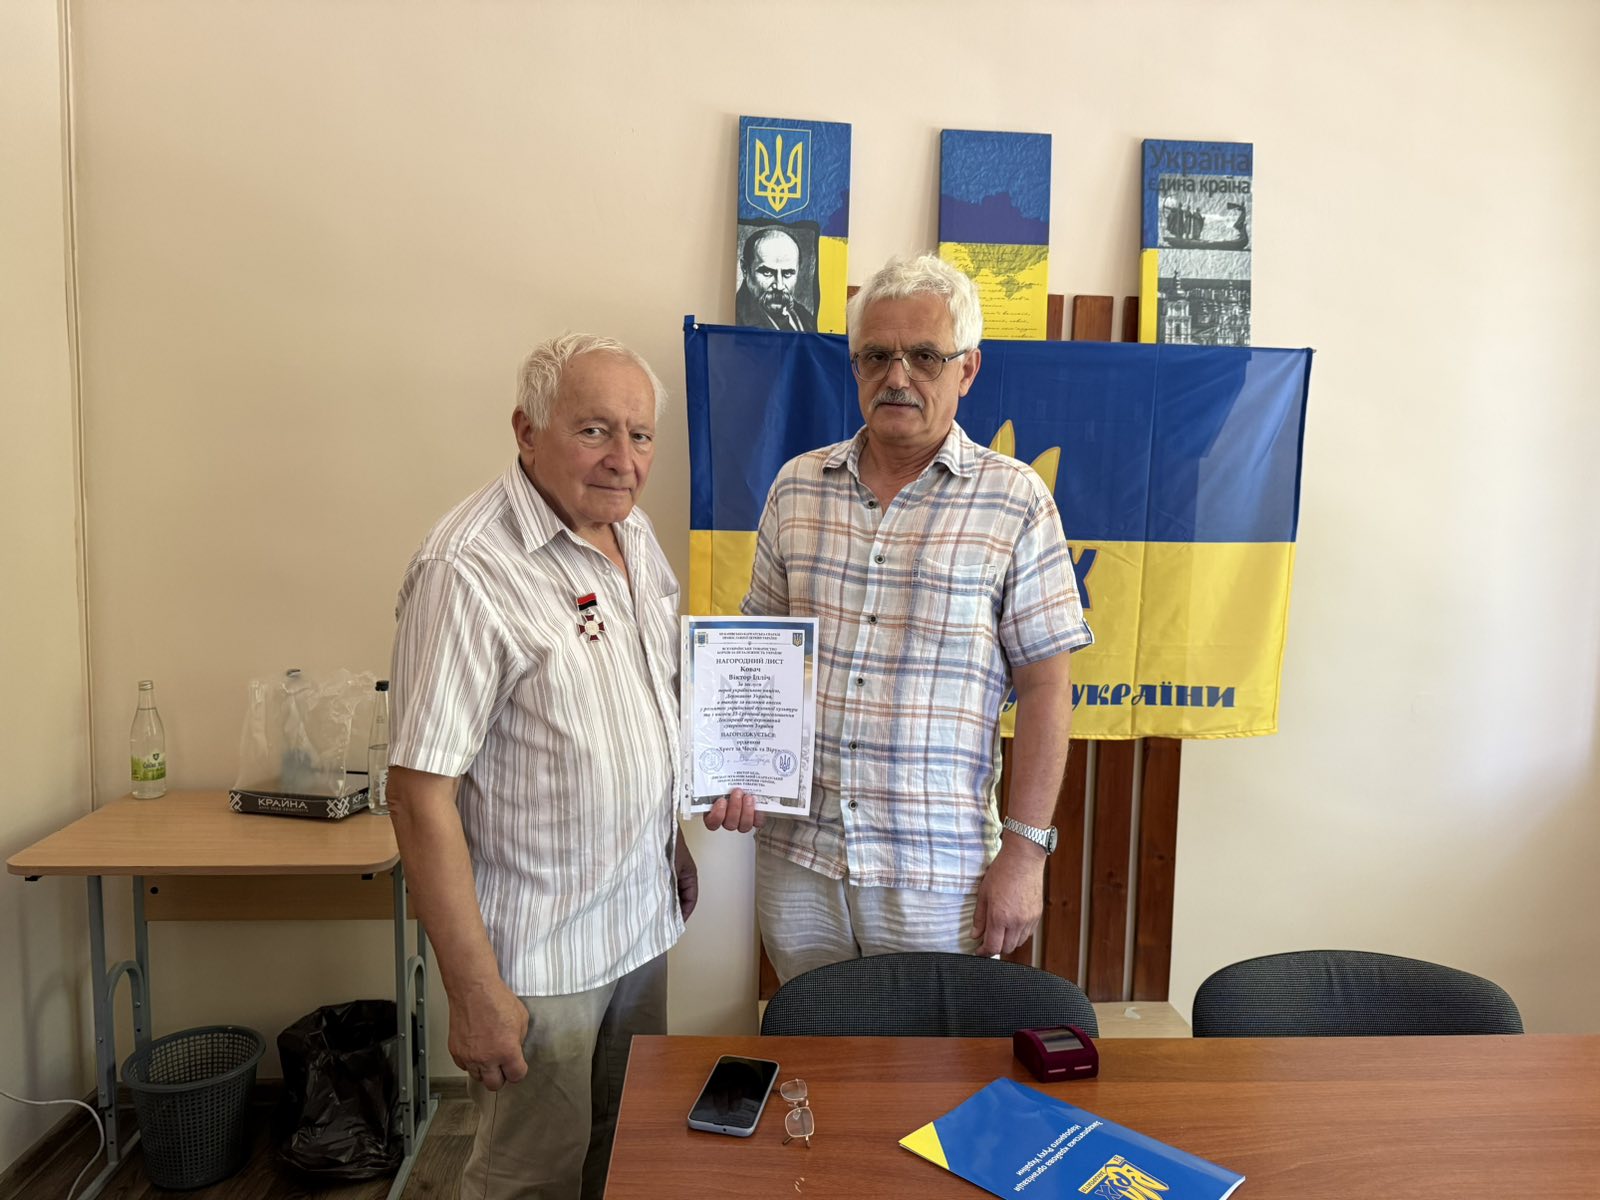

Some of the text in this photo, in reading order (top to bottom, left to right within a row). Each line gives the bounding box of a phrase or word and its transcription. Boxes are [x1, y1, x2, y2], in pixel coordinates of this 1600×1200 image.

[1149, 143, 1250, 177] Україна
[1200, 175, 1251, 198] країна
[1013, 1120, 1104, 1192] Закарпатська крайова організація
[1015, 1123, 1082, 1176] Народного Руху України
